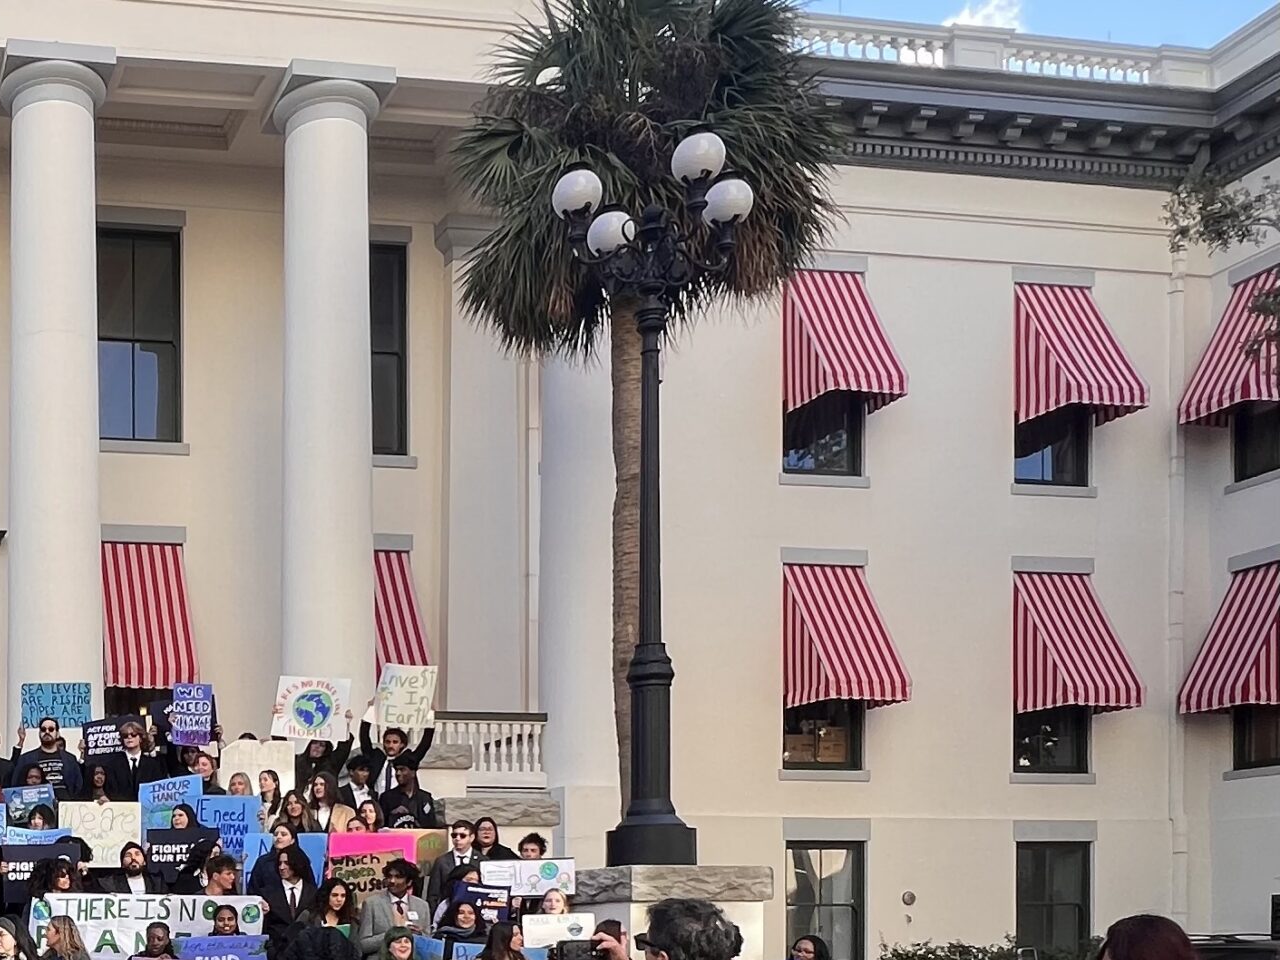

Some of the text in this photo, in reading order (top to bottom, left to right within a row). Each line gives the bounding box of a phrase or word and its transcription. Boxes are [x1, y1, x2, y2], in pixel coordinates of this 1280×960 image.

[21, 684, 91, 695] SEA LEVELS
[21, 695, 91, 706] ARE RISING
[29, 705, 83, 716] PIPES ARE
[175, 702, 211, 714] NEED
[86, 724, 116, 734] ACT FOR
[87, 732, 121, 742] AFFOR
[98, 738, 121, 747] CLEA
[87, 748, 115, 756] ENERGY
[167, 780, 191, 792] OUR
[213, 803, 246, 823] need
[151, 843, 188, 855] FIGHT
[151, 853, 174, 863] OUR
[56, 897, 130, 920] THERE
[134, 898, 172, 920] IS
